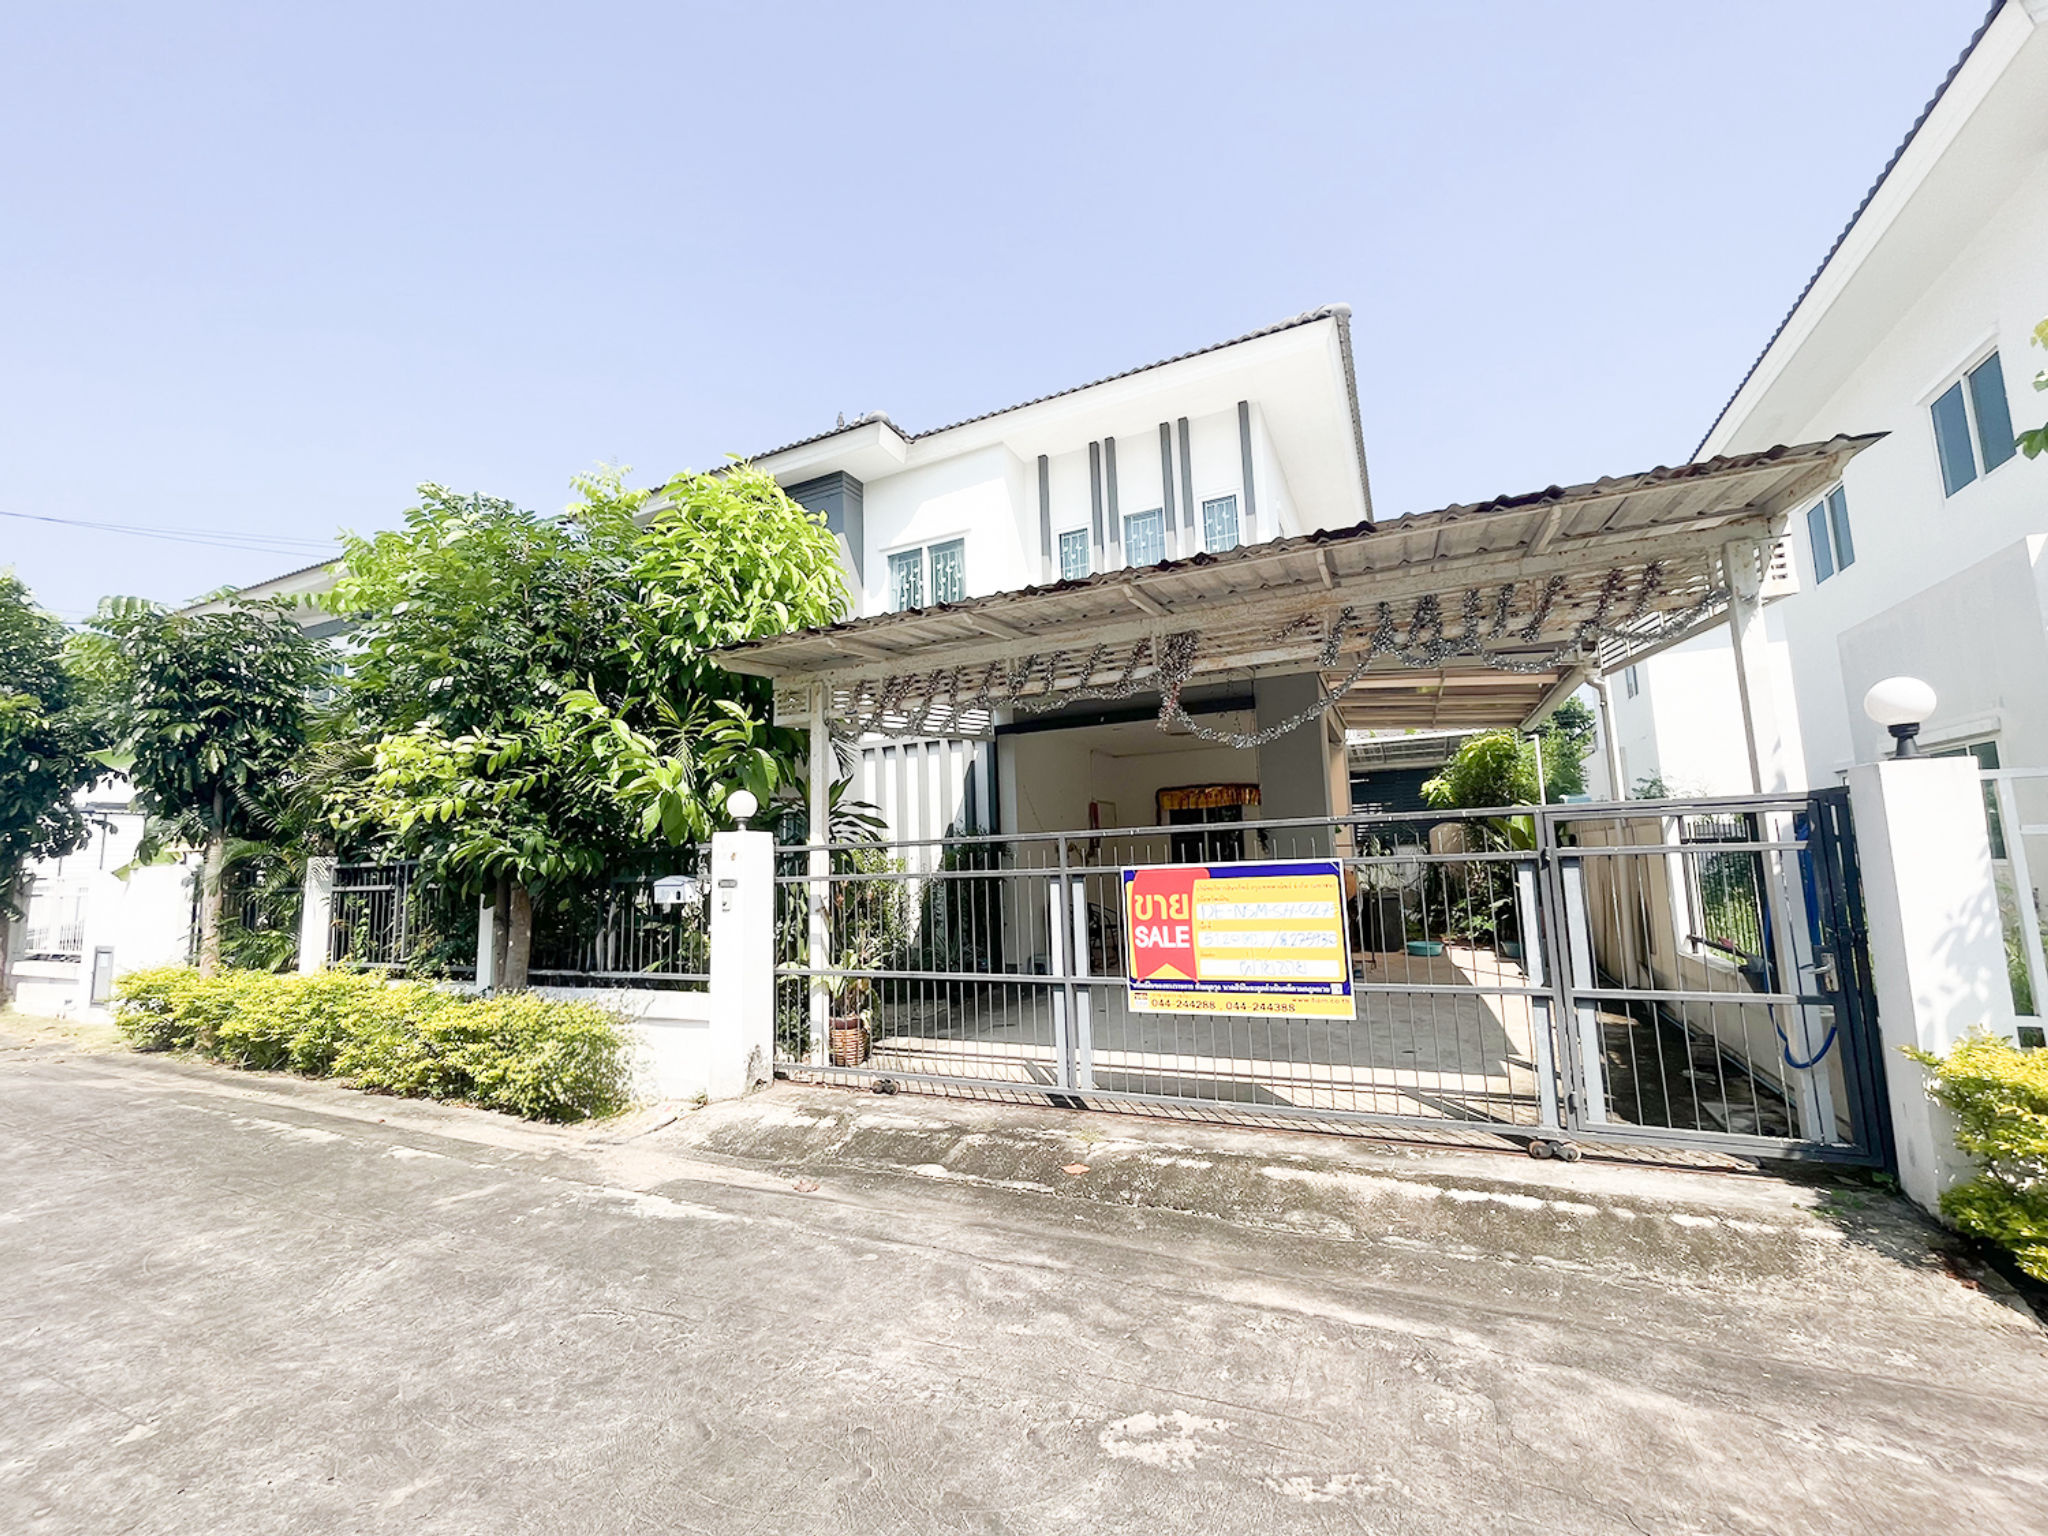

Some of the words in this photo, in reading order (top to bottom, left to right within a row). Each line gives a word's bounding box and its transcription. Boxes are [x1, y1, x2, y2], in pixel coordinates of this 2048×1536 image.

[1134, 893, 1190, 920] ขาย
[1134, 925, 1191, 948] SALE
[1151, 998, 1216, 1010] 044-244288
[1225, 1001, 1296, 1012] 044-244388
